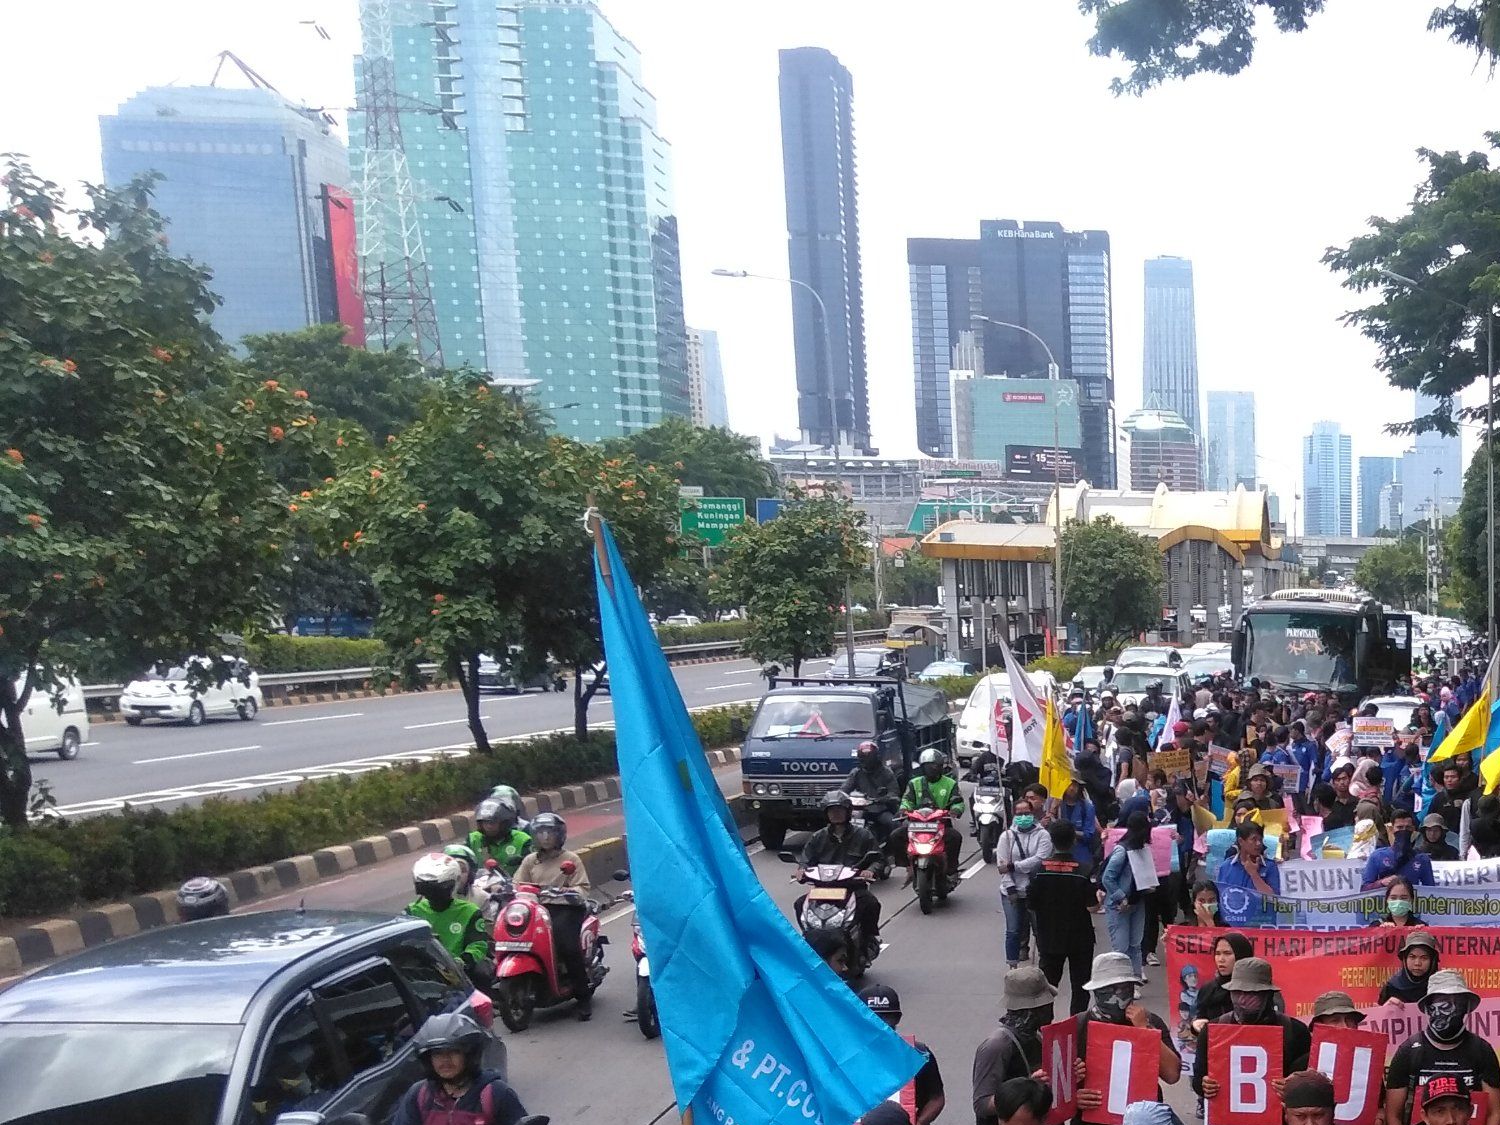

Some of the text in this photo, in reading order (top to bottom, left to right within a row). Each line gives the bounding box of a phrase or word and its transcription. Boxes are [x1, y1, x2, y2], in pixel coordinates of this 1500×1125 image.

[1014, 230, 1034, 238] Hana
[1036, 454, 1046, 462] 15
[698, 503, 740, 512] Semanggi
[697, 512, 740, 520] Kuningan
[781, 762, 839, 772] TOYOTA
[1262, 895, 1300, 913] Hari
[1264, 936, 1305, 956] HARI
[732, 1039, 755, 1070] &
[1051, 1033, 1073, 1109] N
[1229, 1045, 1268, 1114] B
[1317, 1041, 1372, 1121] U
[1428, 1077, 1457, 1091] FIRE
